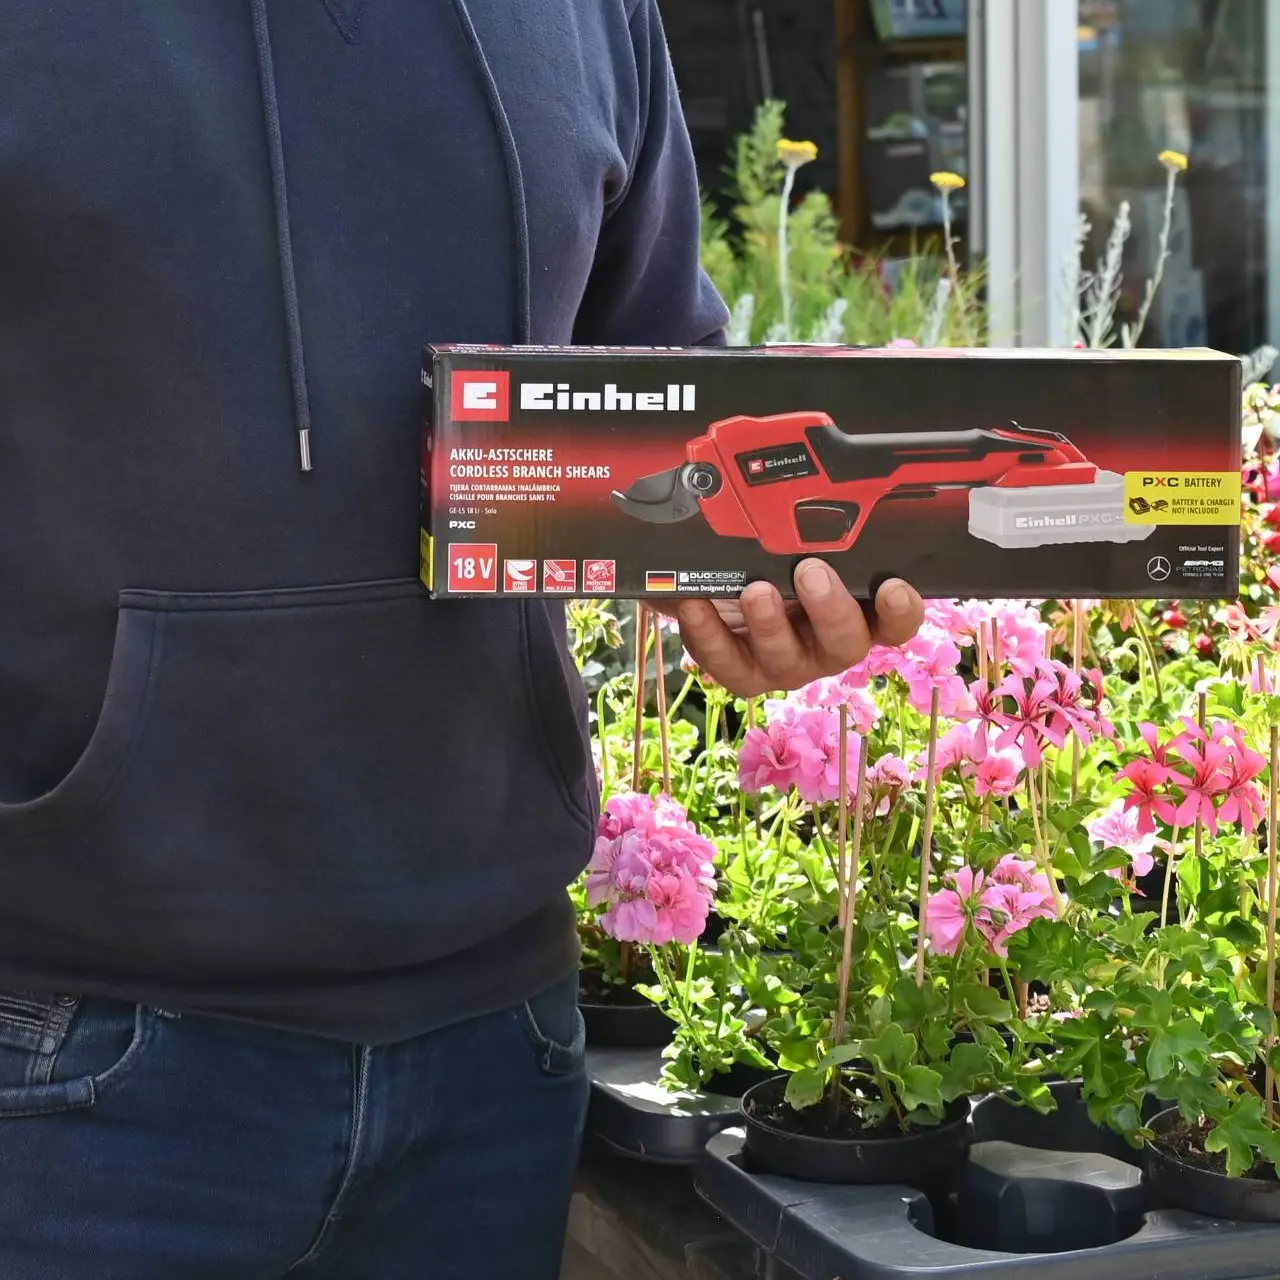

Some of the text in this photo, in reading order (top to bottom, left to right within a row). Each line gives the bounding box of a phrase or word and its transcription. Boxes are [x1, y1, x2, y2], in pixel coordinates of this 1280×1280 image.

[520, 383, 695, 411] Einhell
[449, 448, 553, 461] AKKU-ASTSCHERE
[765, 454, 807, 468] Einhell
[449, 465, 610, 478] CORDLESS BRANCH SHEARS
[1142, 477, 1222, 487] PXC BATTERY
[449, 493, 475, 501] CISAILLE
[495, 493, 527, 501] BRANCHES
[1172, 498, 1198, 506] BATTERY
[1206, 498, 1234, 506] CHARGER
[485, 507, 497, 515] Solo
[449, 521, 476, 529] PXC
[1015, 514, 1076, 528] Einhell
[453, 557, 493, 579] 18 V
[700, 584, 725, 593] Designed
